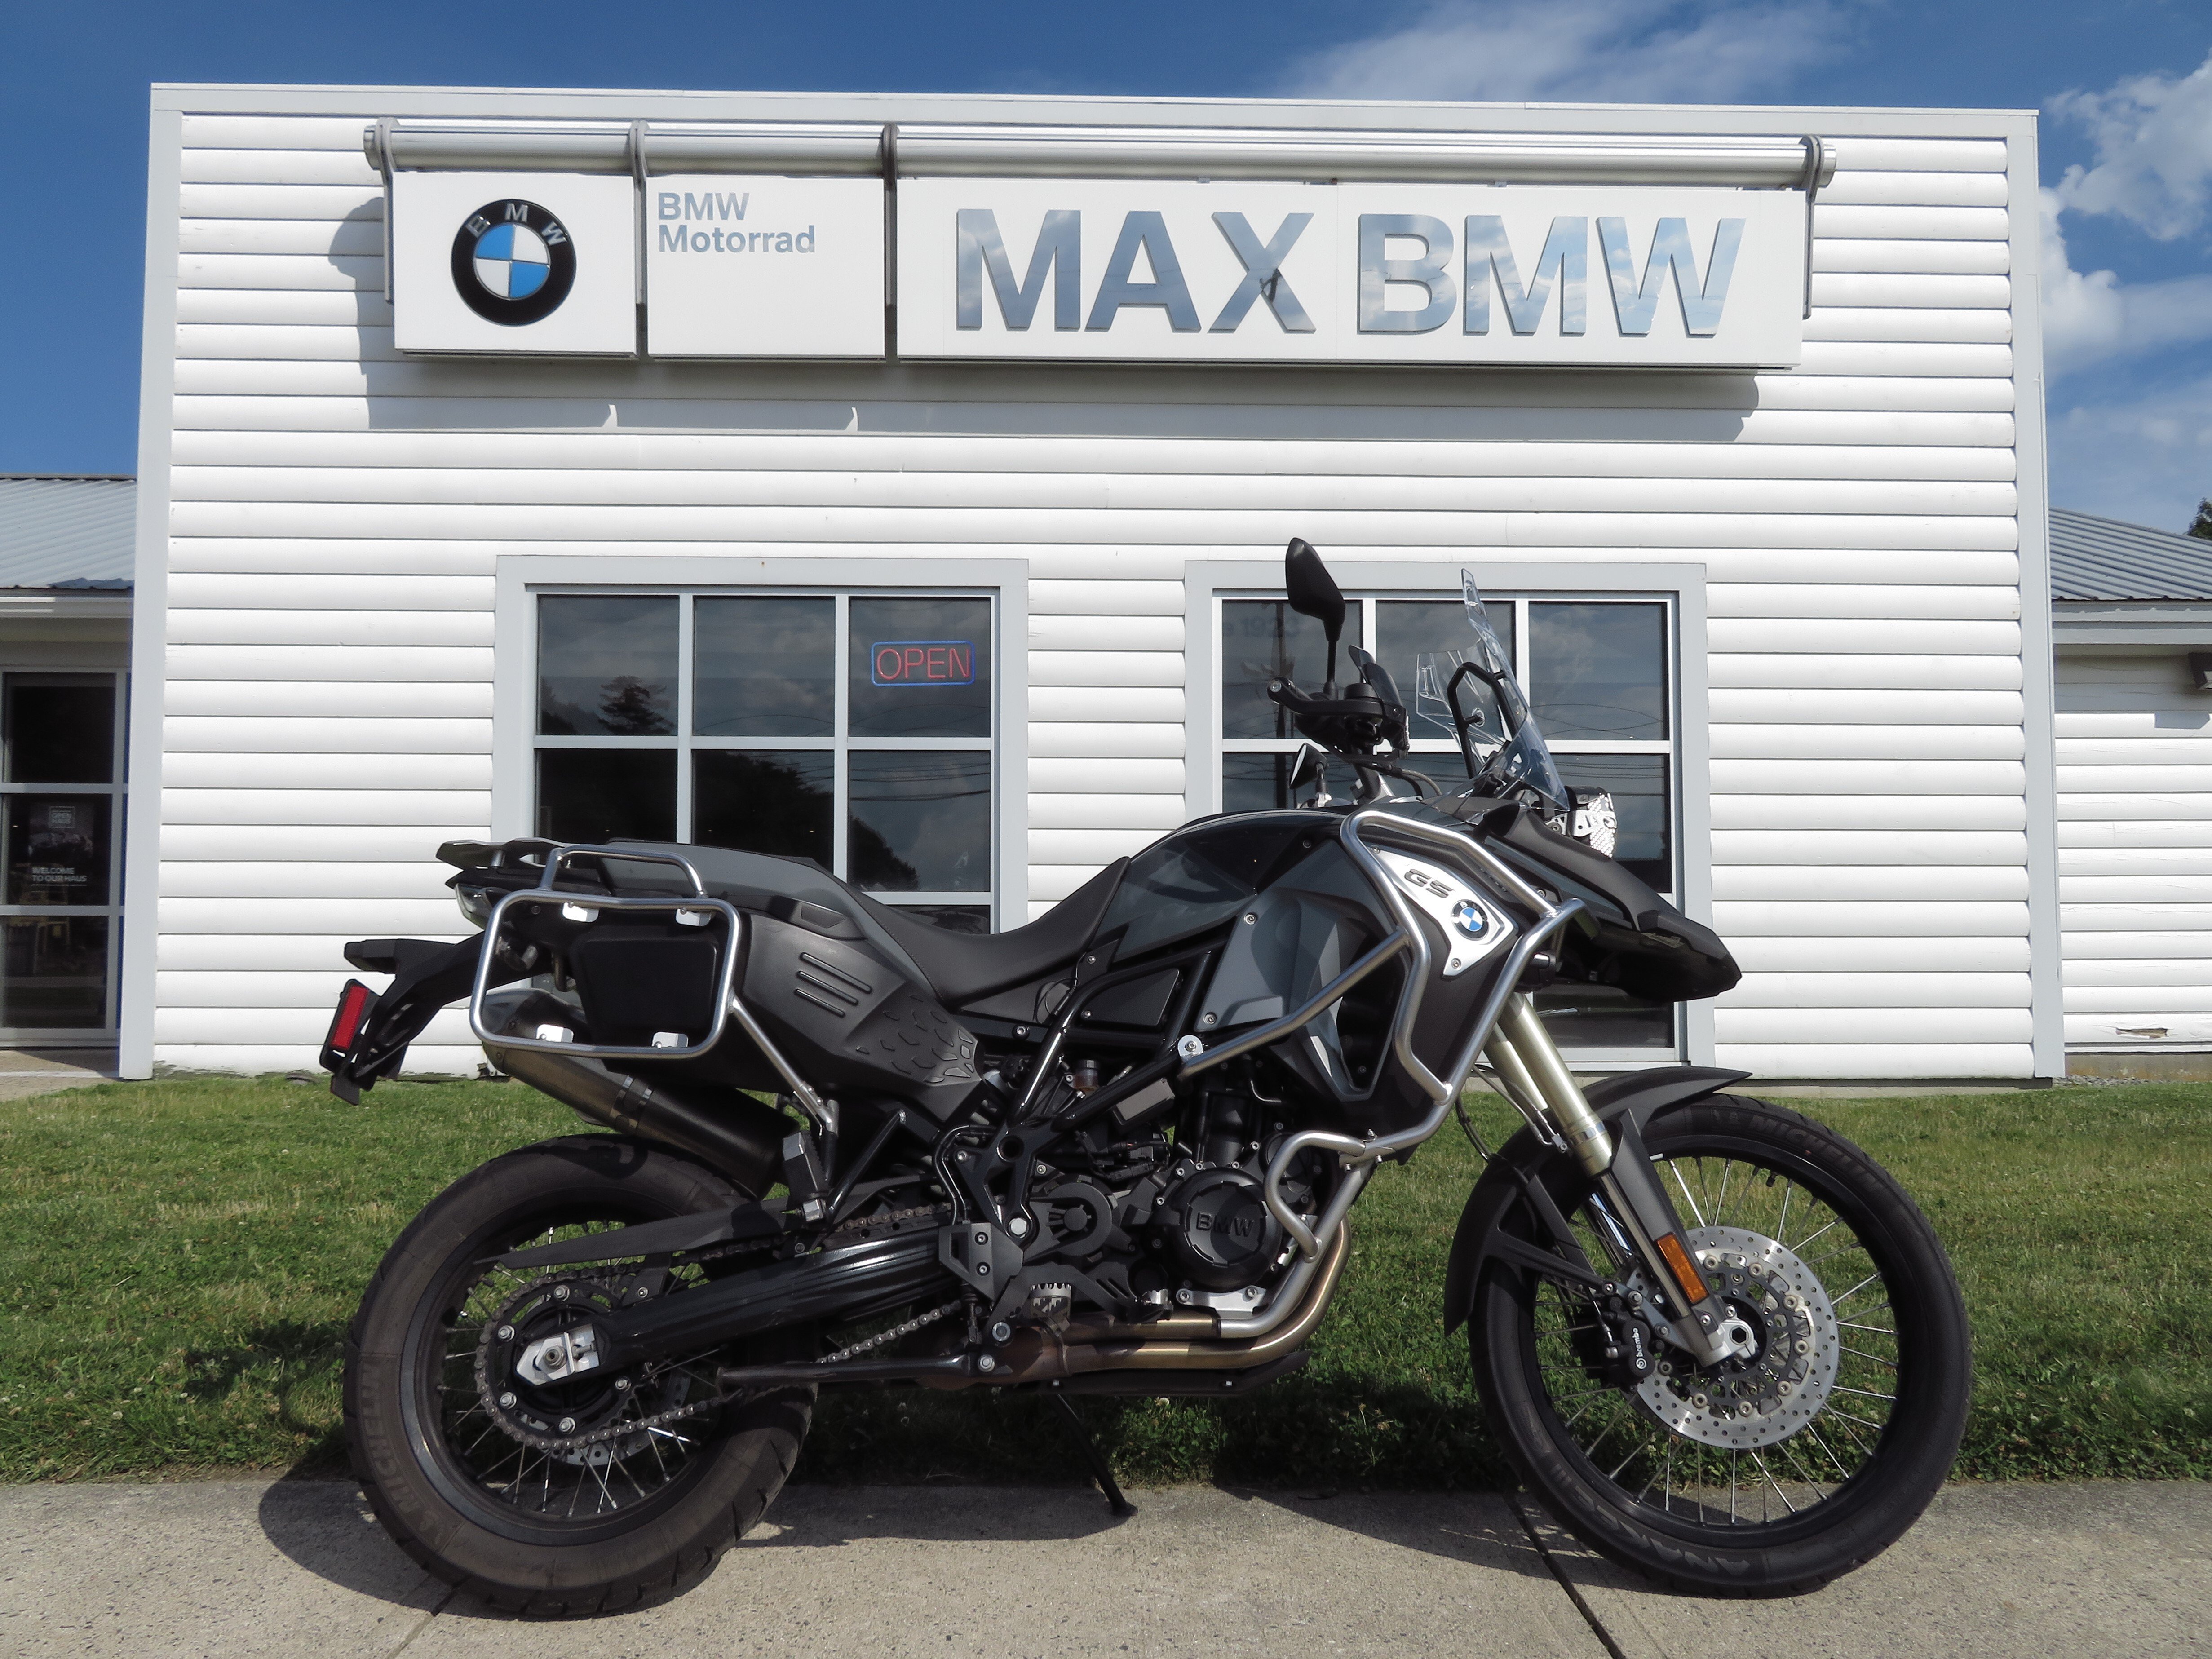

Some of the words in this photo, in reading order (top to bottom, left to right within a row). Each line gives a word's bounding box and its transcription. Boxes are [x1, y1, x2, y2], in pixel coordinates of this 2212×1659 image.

[658, 192, 750, 220] BMW
[466, 203, 567, 246] BMW
[659, 224, 815, 253] Motorrad
[956, 208, 1316, 334] MAX
[1357, 213, 1746, 338] BMW
[876, 648, 970, 680] OPEN
[1404, 869, 1454, 898] GS
[1197, 1212, 1255, 1237] BMW
[1632, 1328, 1643, 1357] brembo
